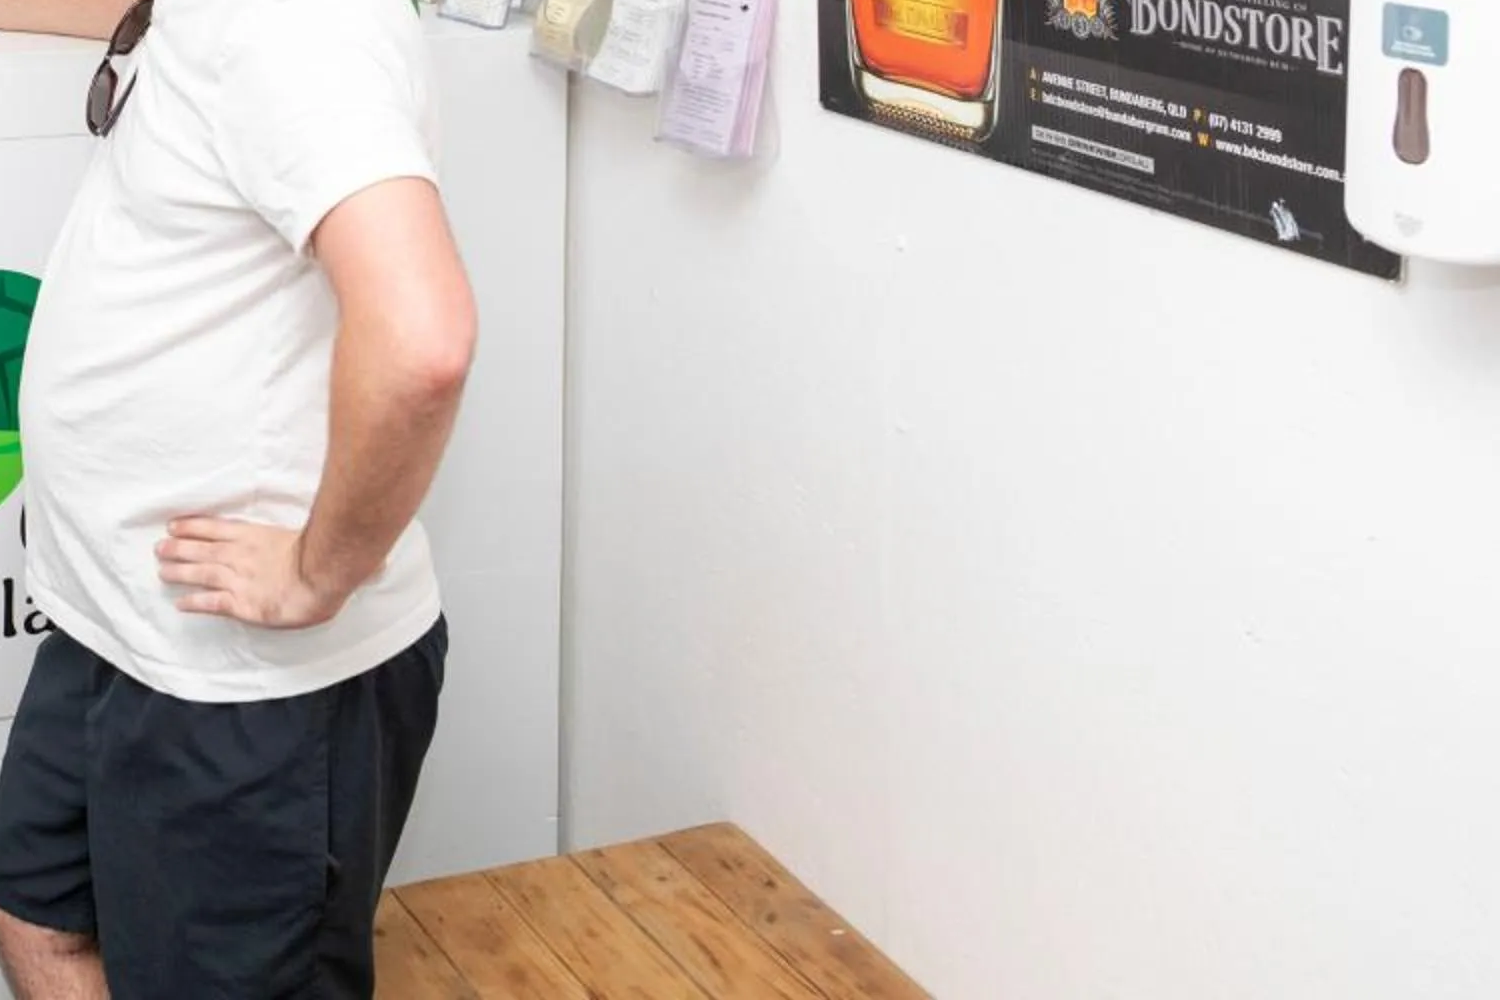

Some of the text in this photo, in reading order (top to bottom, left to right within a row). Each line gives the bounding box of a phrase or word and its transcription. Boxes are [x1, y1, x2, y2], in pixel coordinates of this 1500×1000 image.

[1167, 102, 1187, 119] QLD
[1209, 112, 1228, 132] (07)
[1230, 118, 1253, 136] 4131
[1256, 125, 1282, 143] 2999
